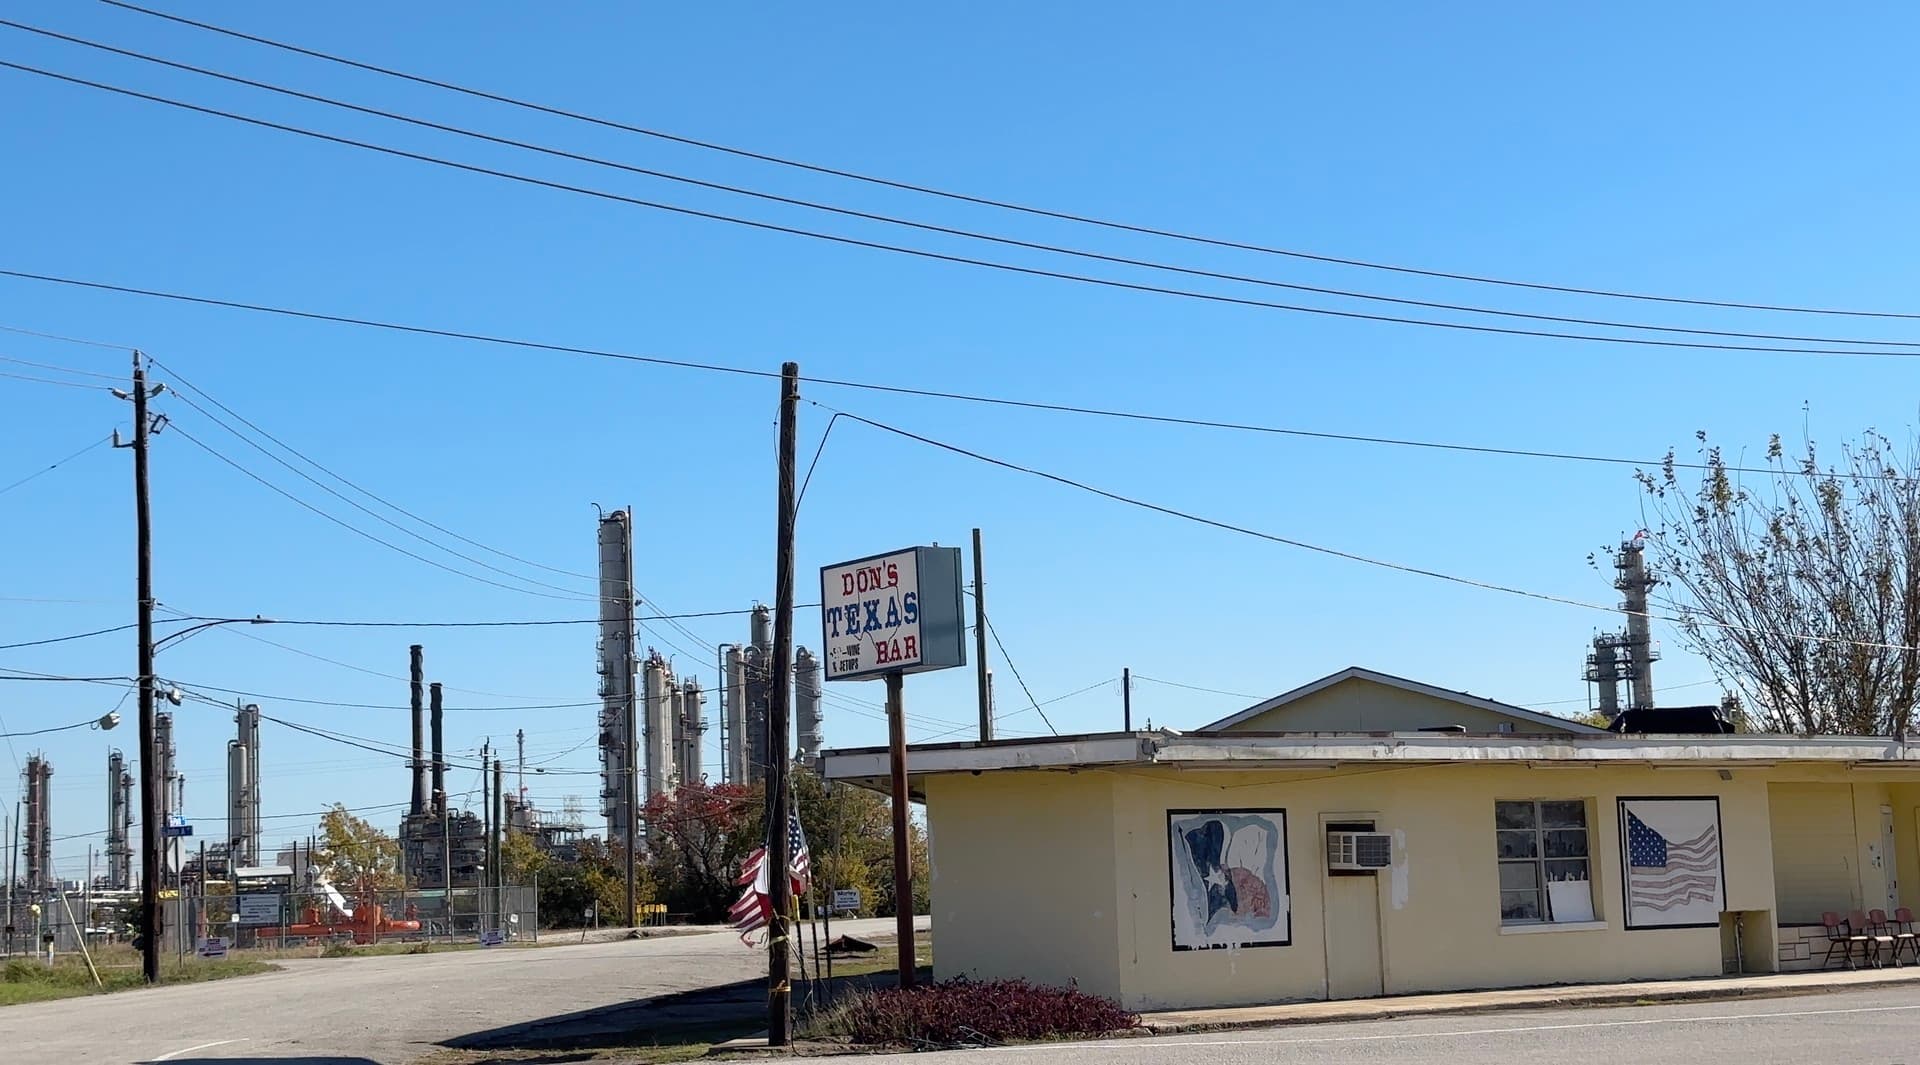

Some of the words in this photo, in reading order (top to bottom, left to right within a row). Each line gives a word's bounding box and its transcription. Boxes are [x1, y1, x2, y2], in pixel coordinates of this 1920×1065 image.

[841, 560, 898, 596] DON'S
[826, 592, 918, 638] TEXAS
[876, 635, 918, 664] BAR
